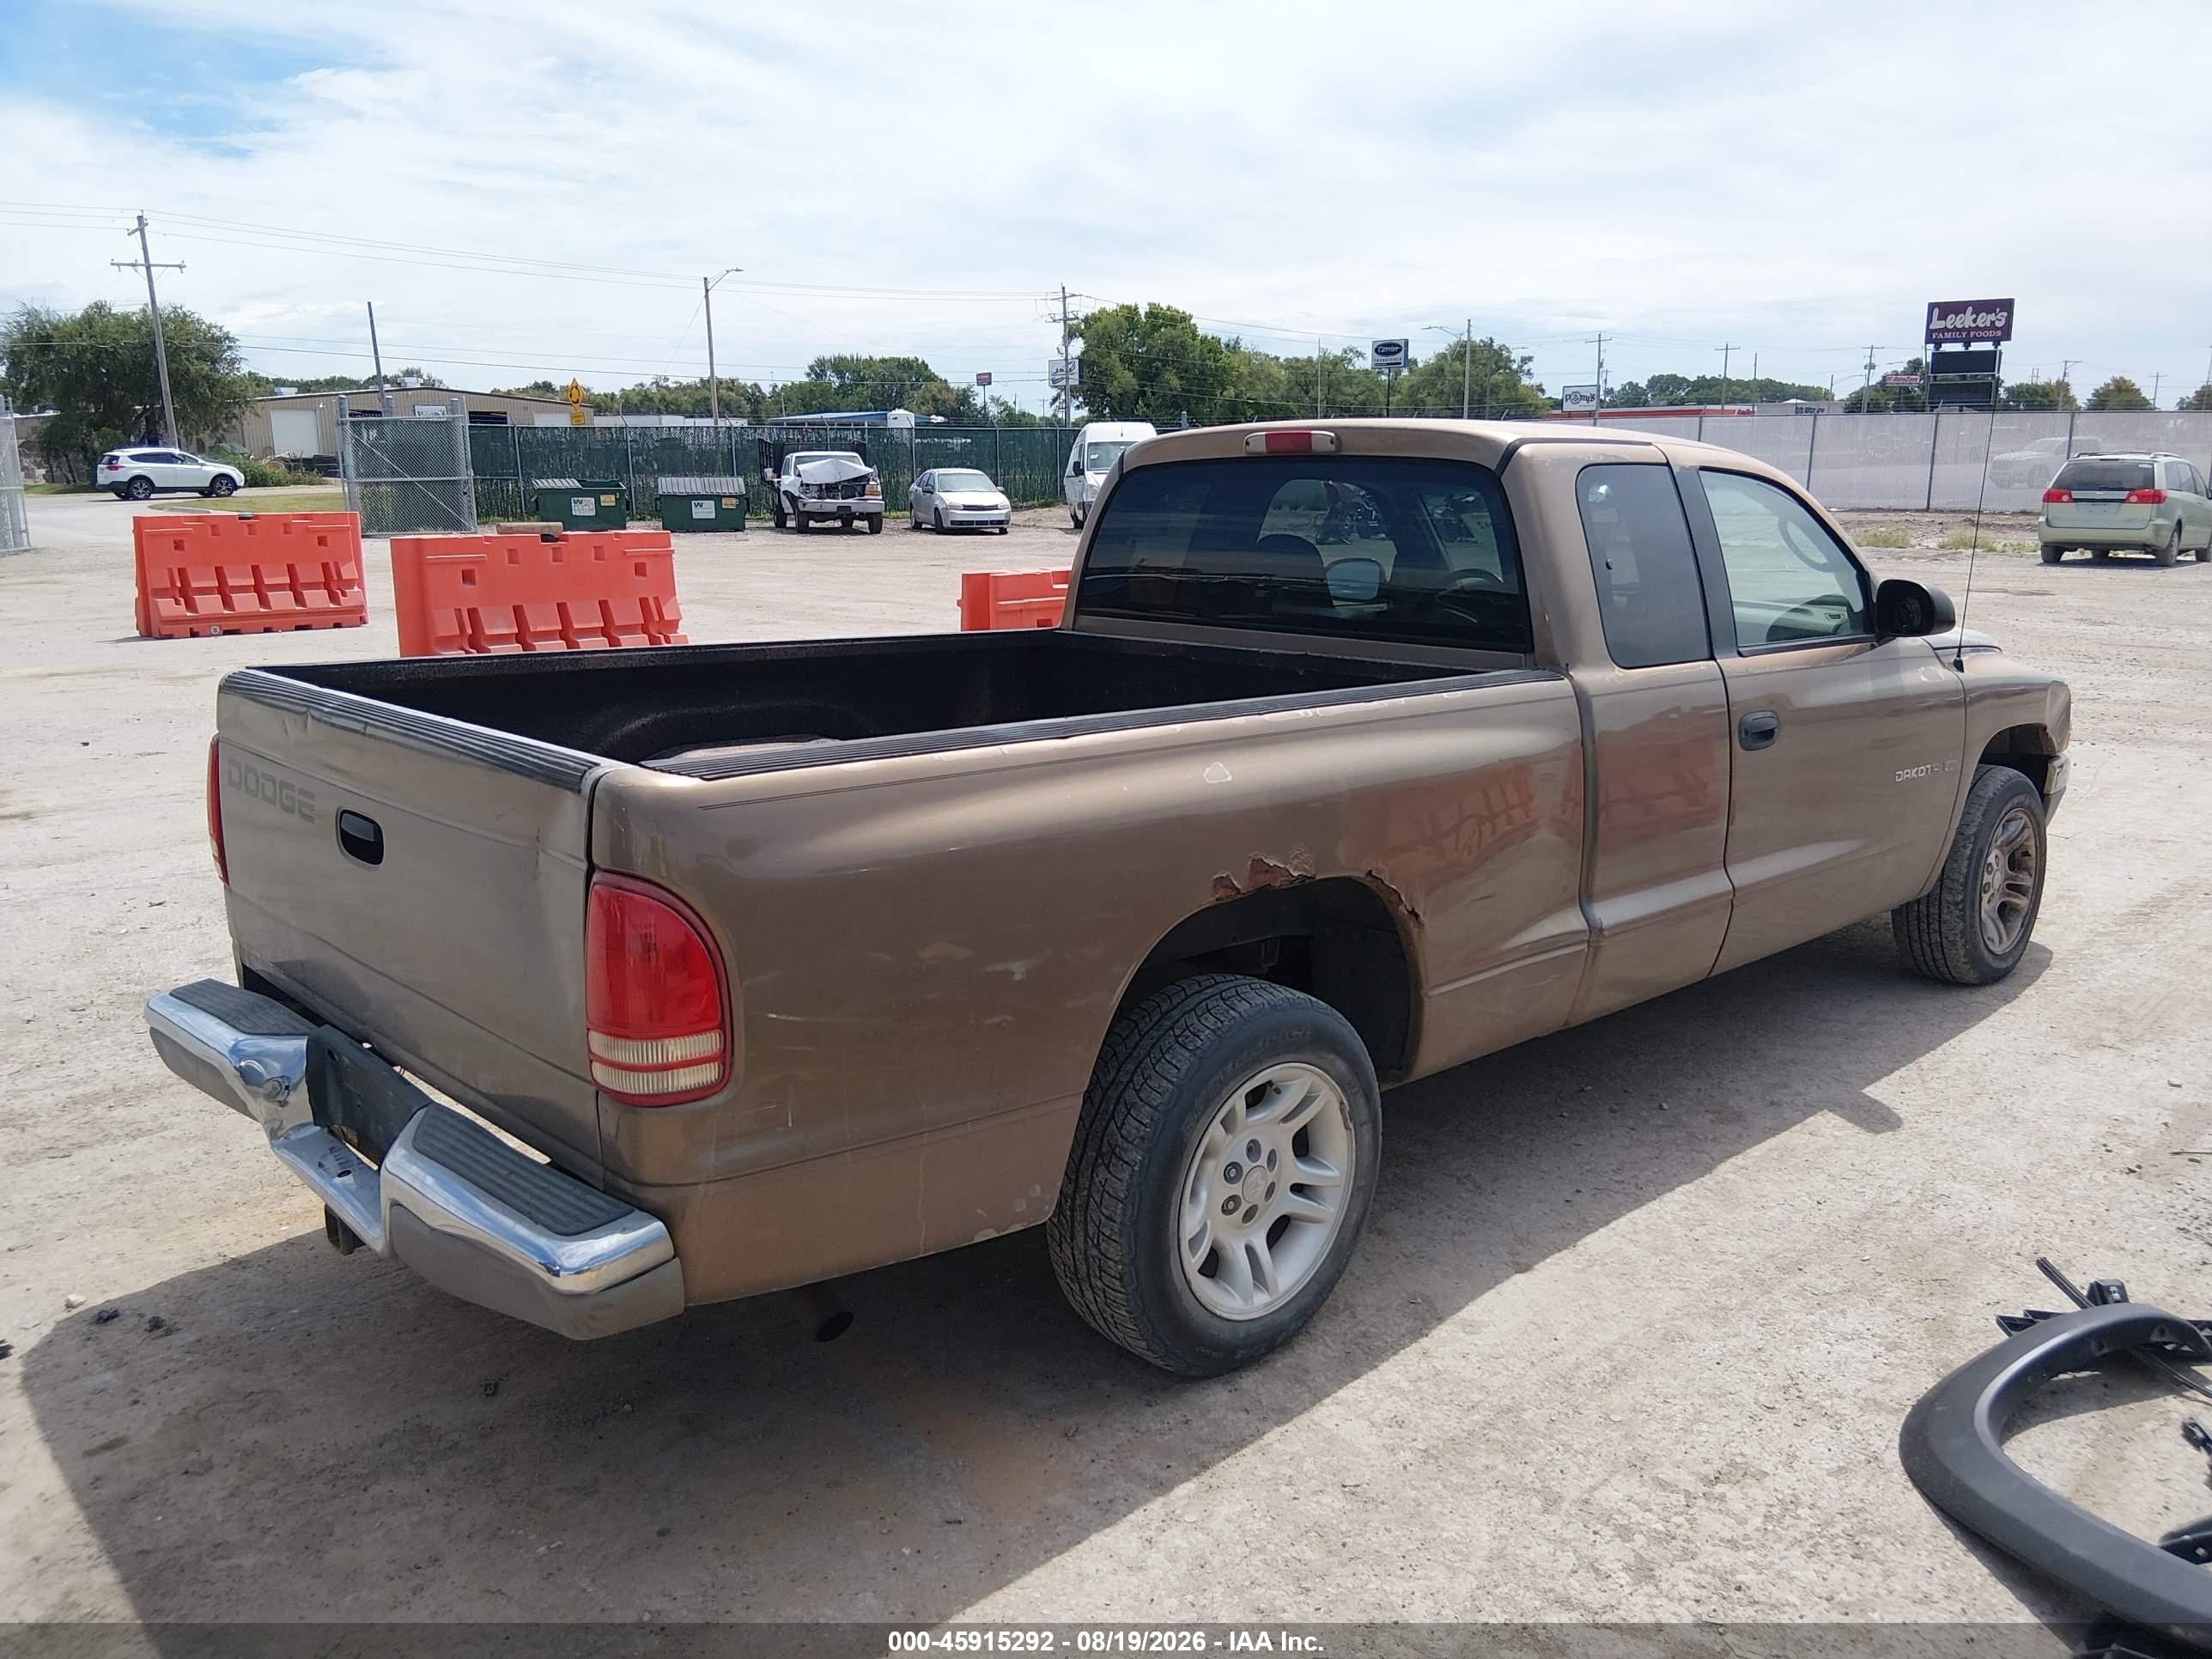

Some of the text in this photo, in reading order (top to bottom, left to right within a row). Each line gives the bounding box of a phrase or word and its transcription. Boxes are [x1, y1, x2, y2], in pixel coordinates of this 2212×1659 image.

[1929, 307, 2008, 330] Leeker's
[1377, 344, 1401, 353] Carrier
[228, 757, 316, 824] DODGE
